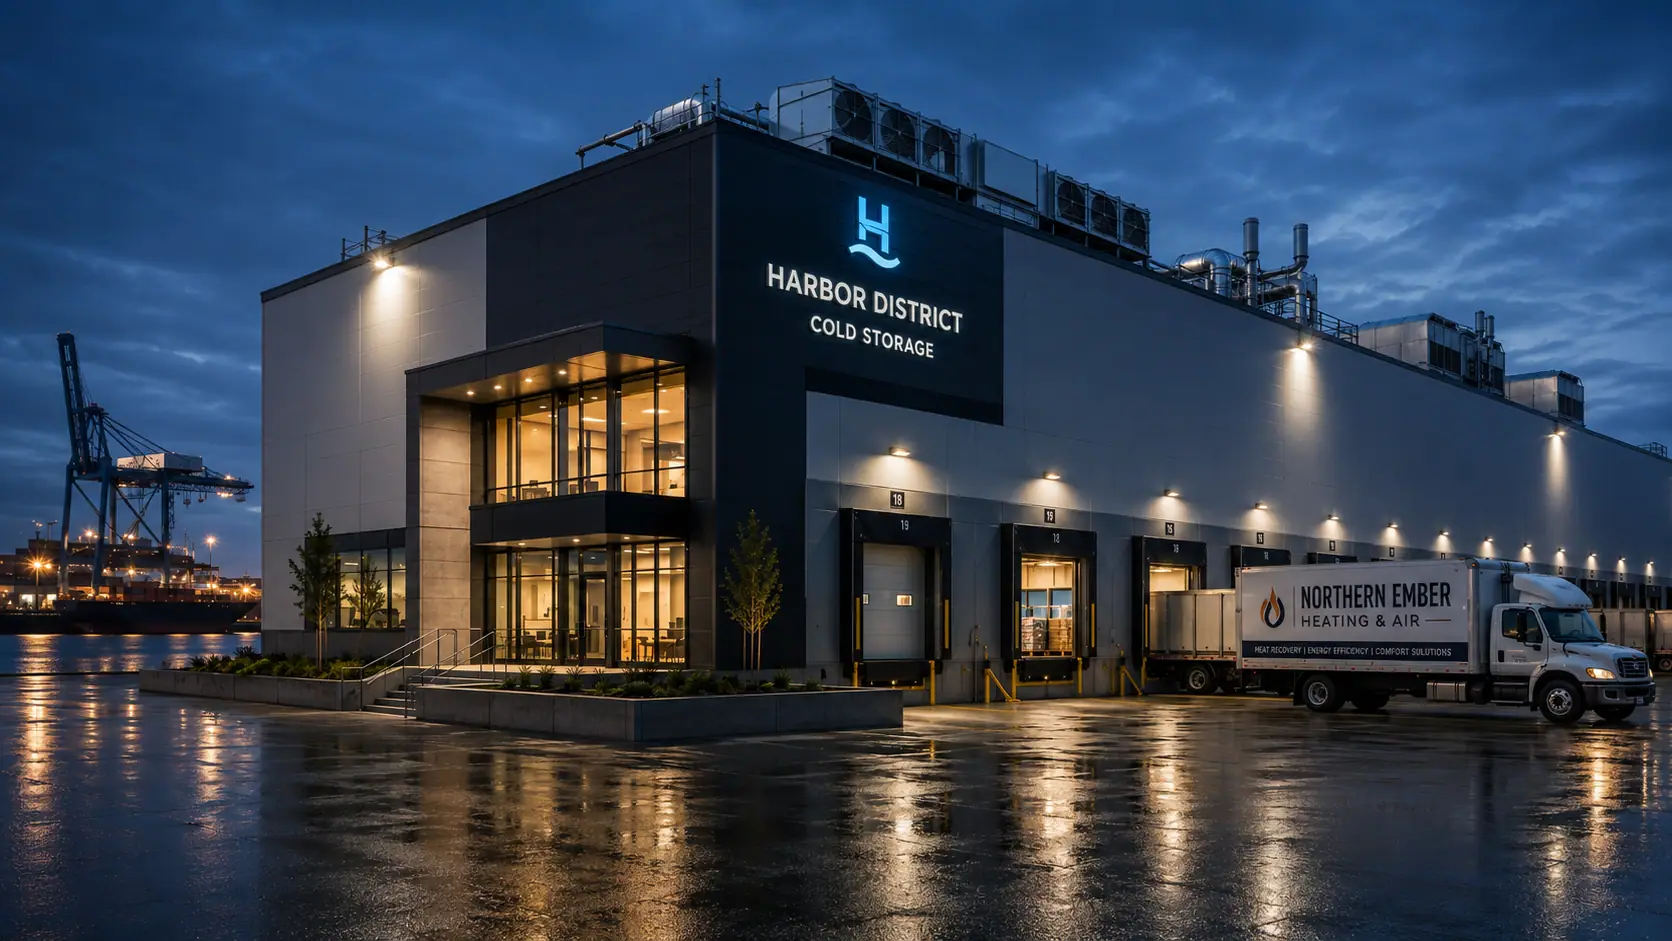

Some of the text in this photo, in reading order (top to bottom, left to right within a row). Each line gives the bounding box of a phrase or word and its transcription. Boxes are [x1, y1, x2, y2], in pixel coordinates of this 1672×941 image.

[858, 195, 889, 254] H
[767, 262, 964, 334] HARBOR DISTRICT
[810, 315, 935, 359] COLD STORAGE
[893, 493, 903, 506] 18
[901, 519, 909, 531] 19
[1301, 581, 1452, 609] NORTHERN EMBER
[1301, 614, 1420, 628] HEATING & AIR
[1270, 646, 1302, 654] RECOVERY
[1375, 647, 1410, 656] COMFORT
